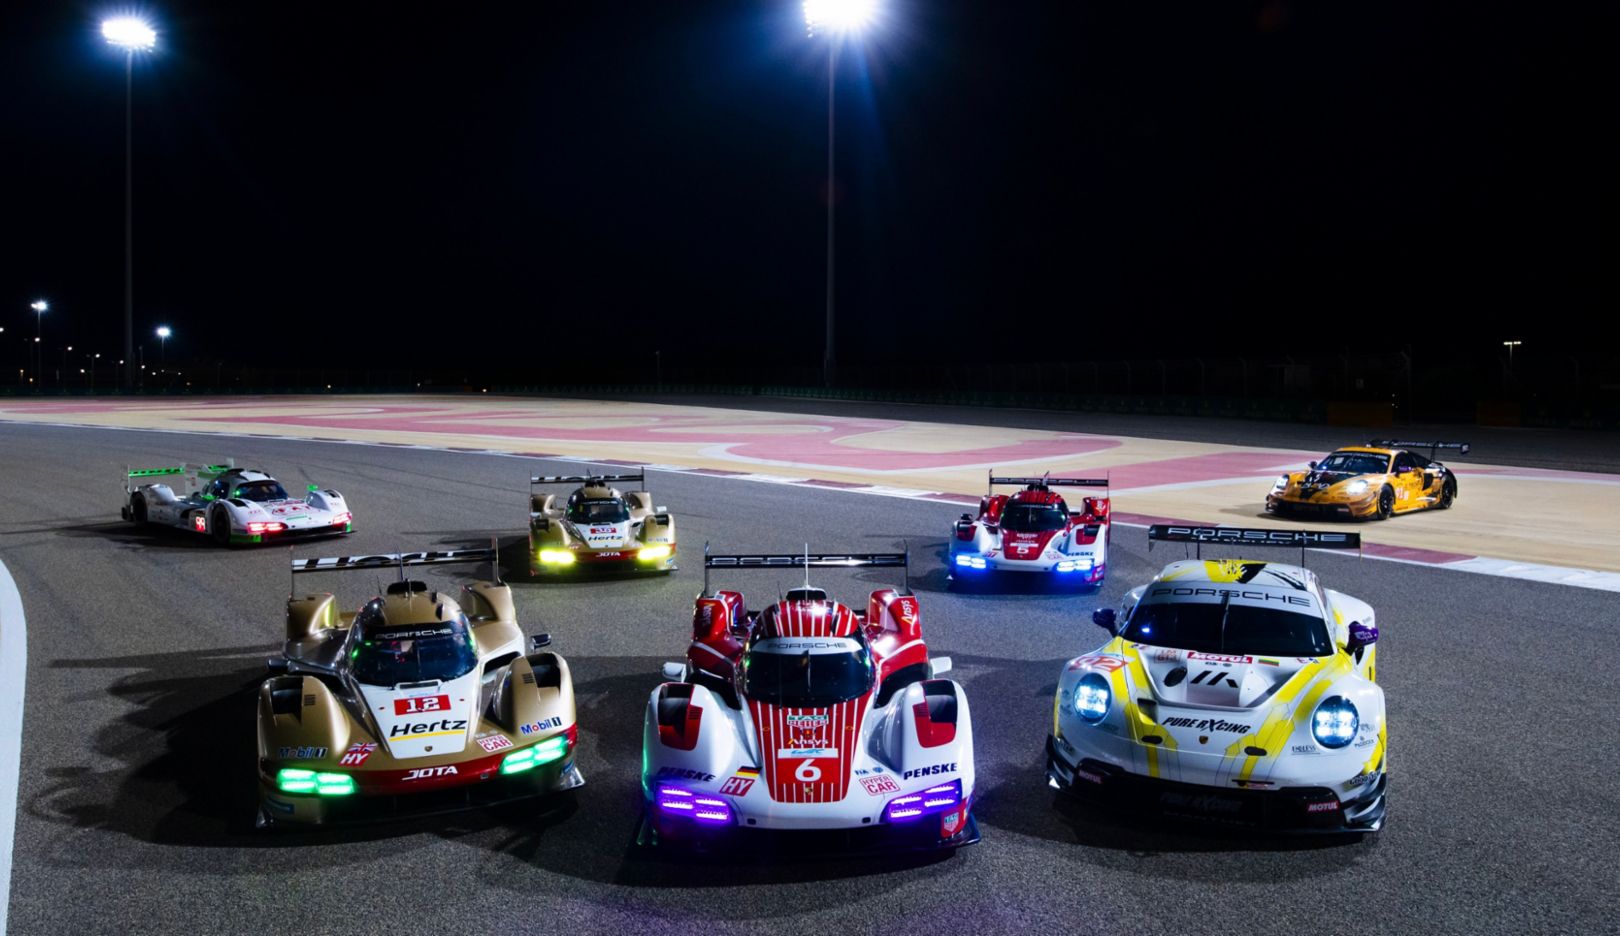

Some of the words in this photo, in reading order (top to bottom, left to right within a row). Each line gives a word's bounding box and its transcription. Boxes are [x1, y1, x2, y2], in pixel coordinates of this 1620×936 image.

[1168, 527, 1346, 542] PORSCHE
[1152, 588, 1311, 608] PORSCHE
[901, 599, 914, 626] Ansys
[375, 628, 453, 640] PORSCHE
[767, 641, 847, 650] PORSCHE
[1193, 652, 1247, 664] MOTUL
[405, 696, 441, 714] 12
[389, 719, 467, 737] Hertz
[520, 720, 553, 735] Mobil
[552, 716, 562, 728] 1
[1161, 716, 1196, 729] PURE
[484, 739, 512, 751] CAR
[341, 753, 368, 764] HY
[402, 766, 459, 781] JOTA
[657, 767, 716, 782] PENSKE
[795, 758, 822, 782] 6
[903, 763, 958, 780] PENSKE
[725, 778, 750, 793] HY
[862, 775, 890, 785] HYPER
[867, 781, 897, 793] CAR
[1308, 802, 1338, 812] MOTUL
